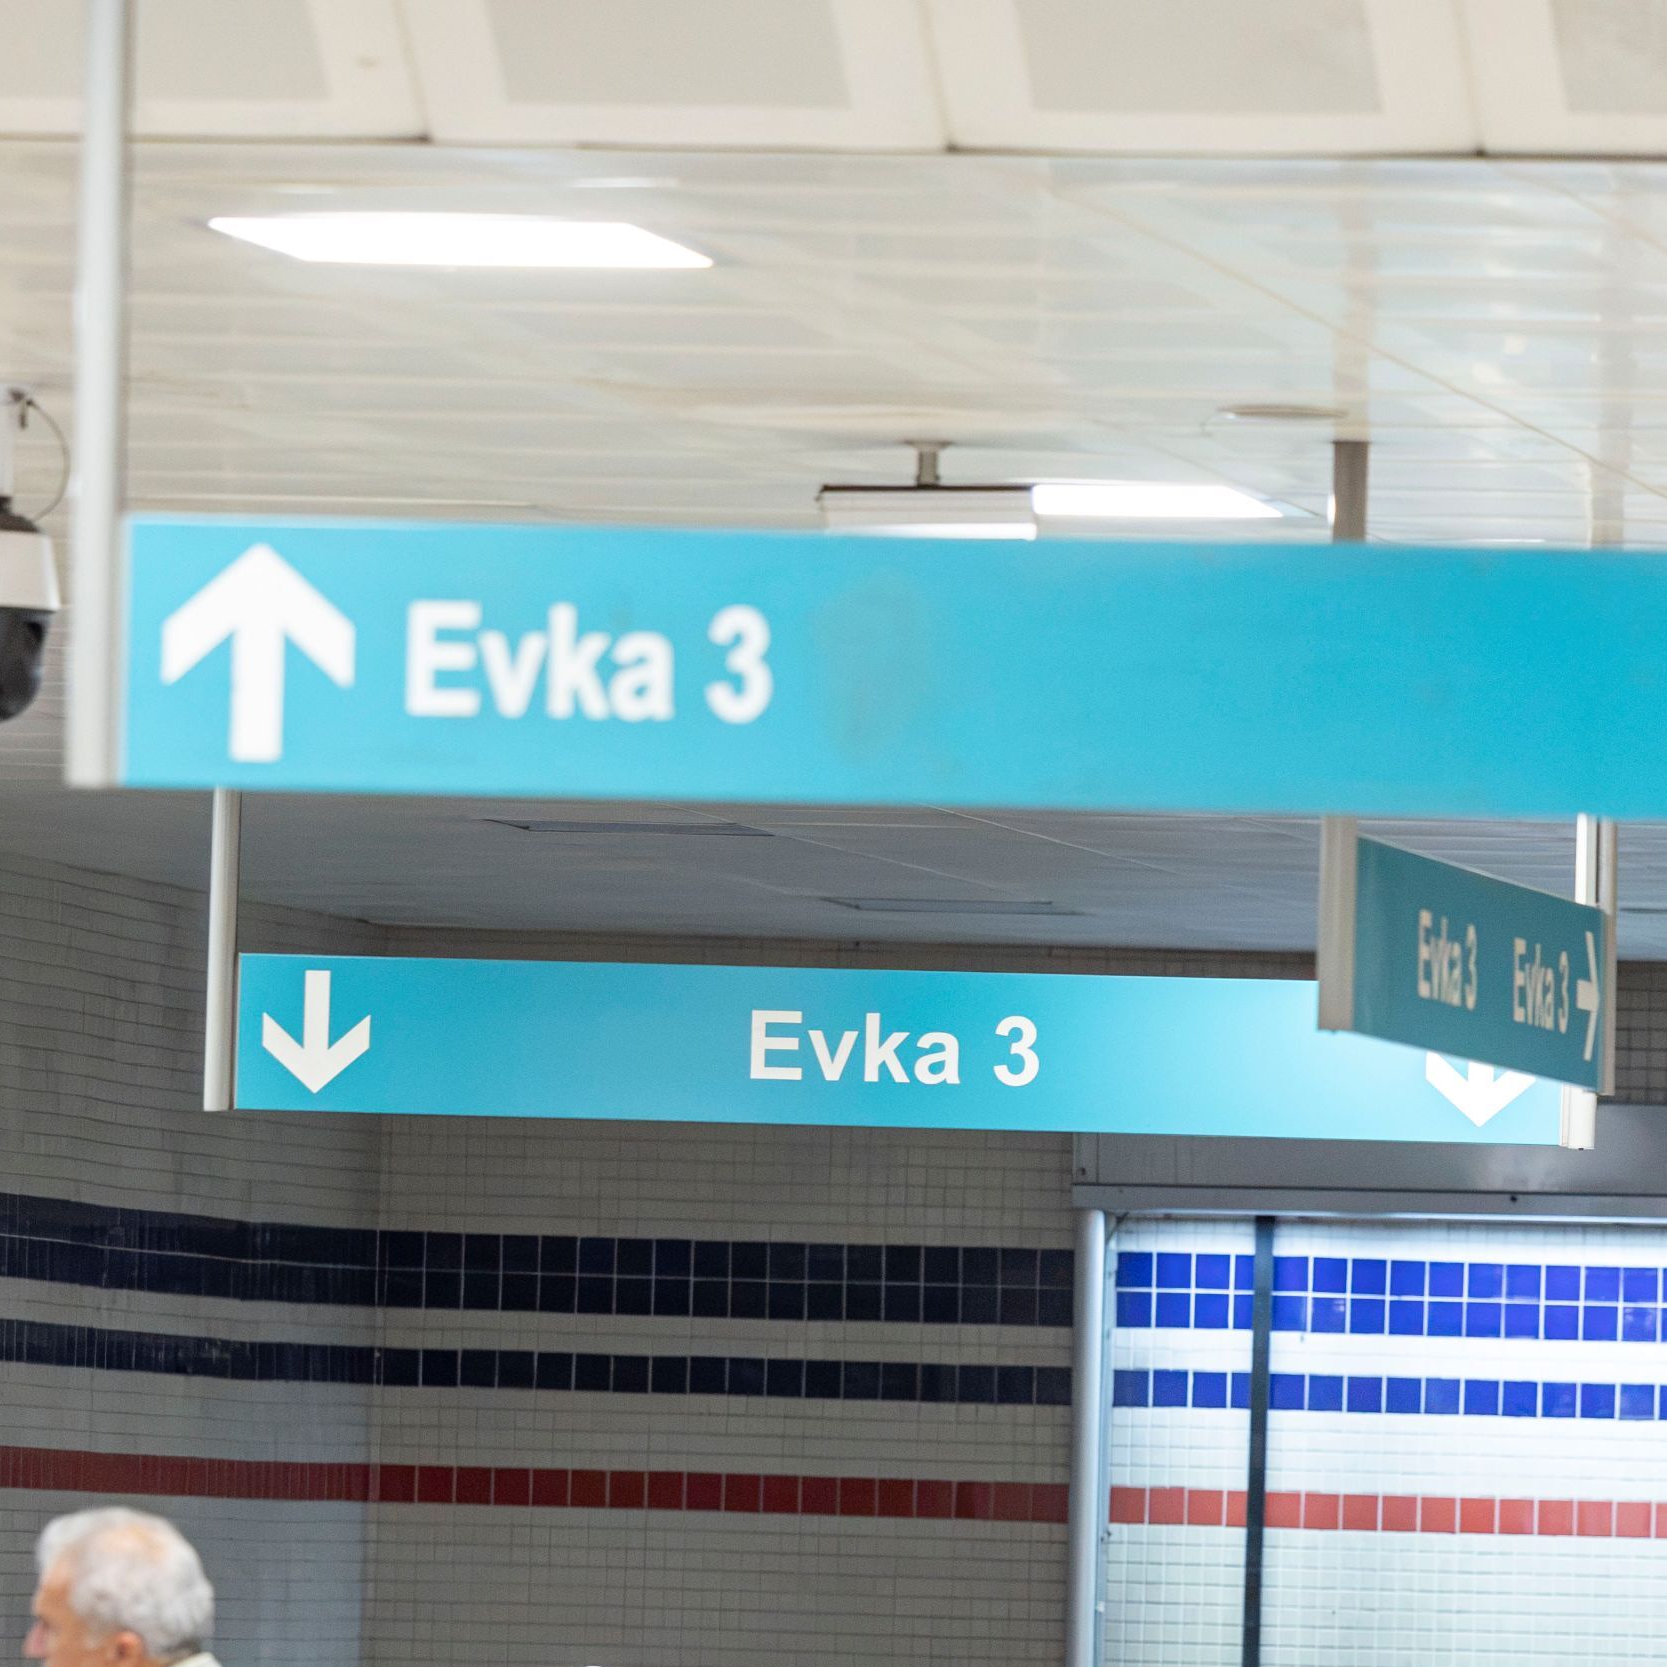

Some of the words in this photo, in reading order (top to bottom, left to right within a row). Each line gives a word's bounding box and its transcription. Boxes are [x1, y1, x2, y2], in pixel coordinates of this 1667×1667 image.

[406, 599, 675, 723] Evka
[704, 603, 775, 726] 3
[1418, 908, 1463, 1008] Evka
[1465, 923, 1478, 1012] 3
[1513, 936, 1555, 1031] Evka
[1558, 950, 1570, 1035] 3
[749, 1009, 961, 1085] Evka
[992, 1014, 1041, 1088] 3
